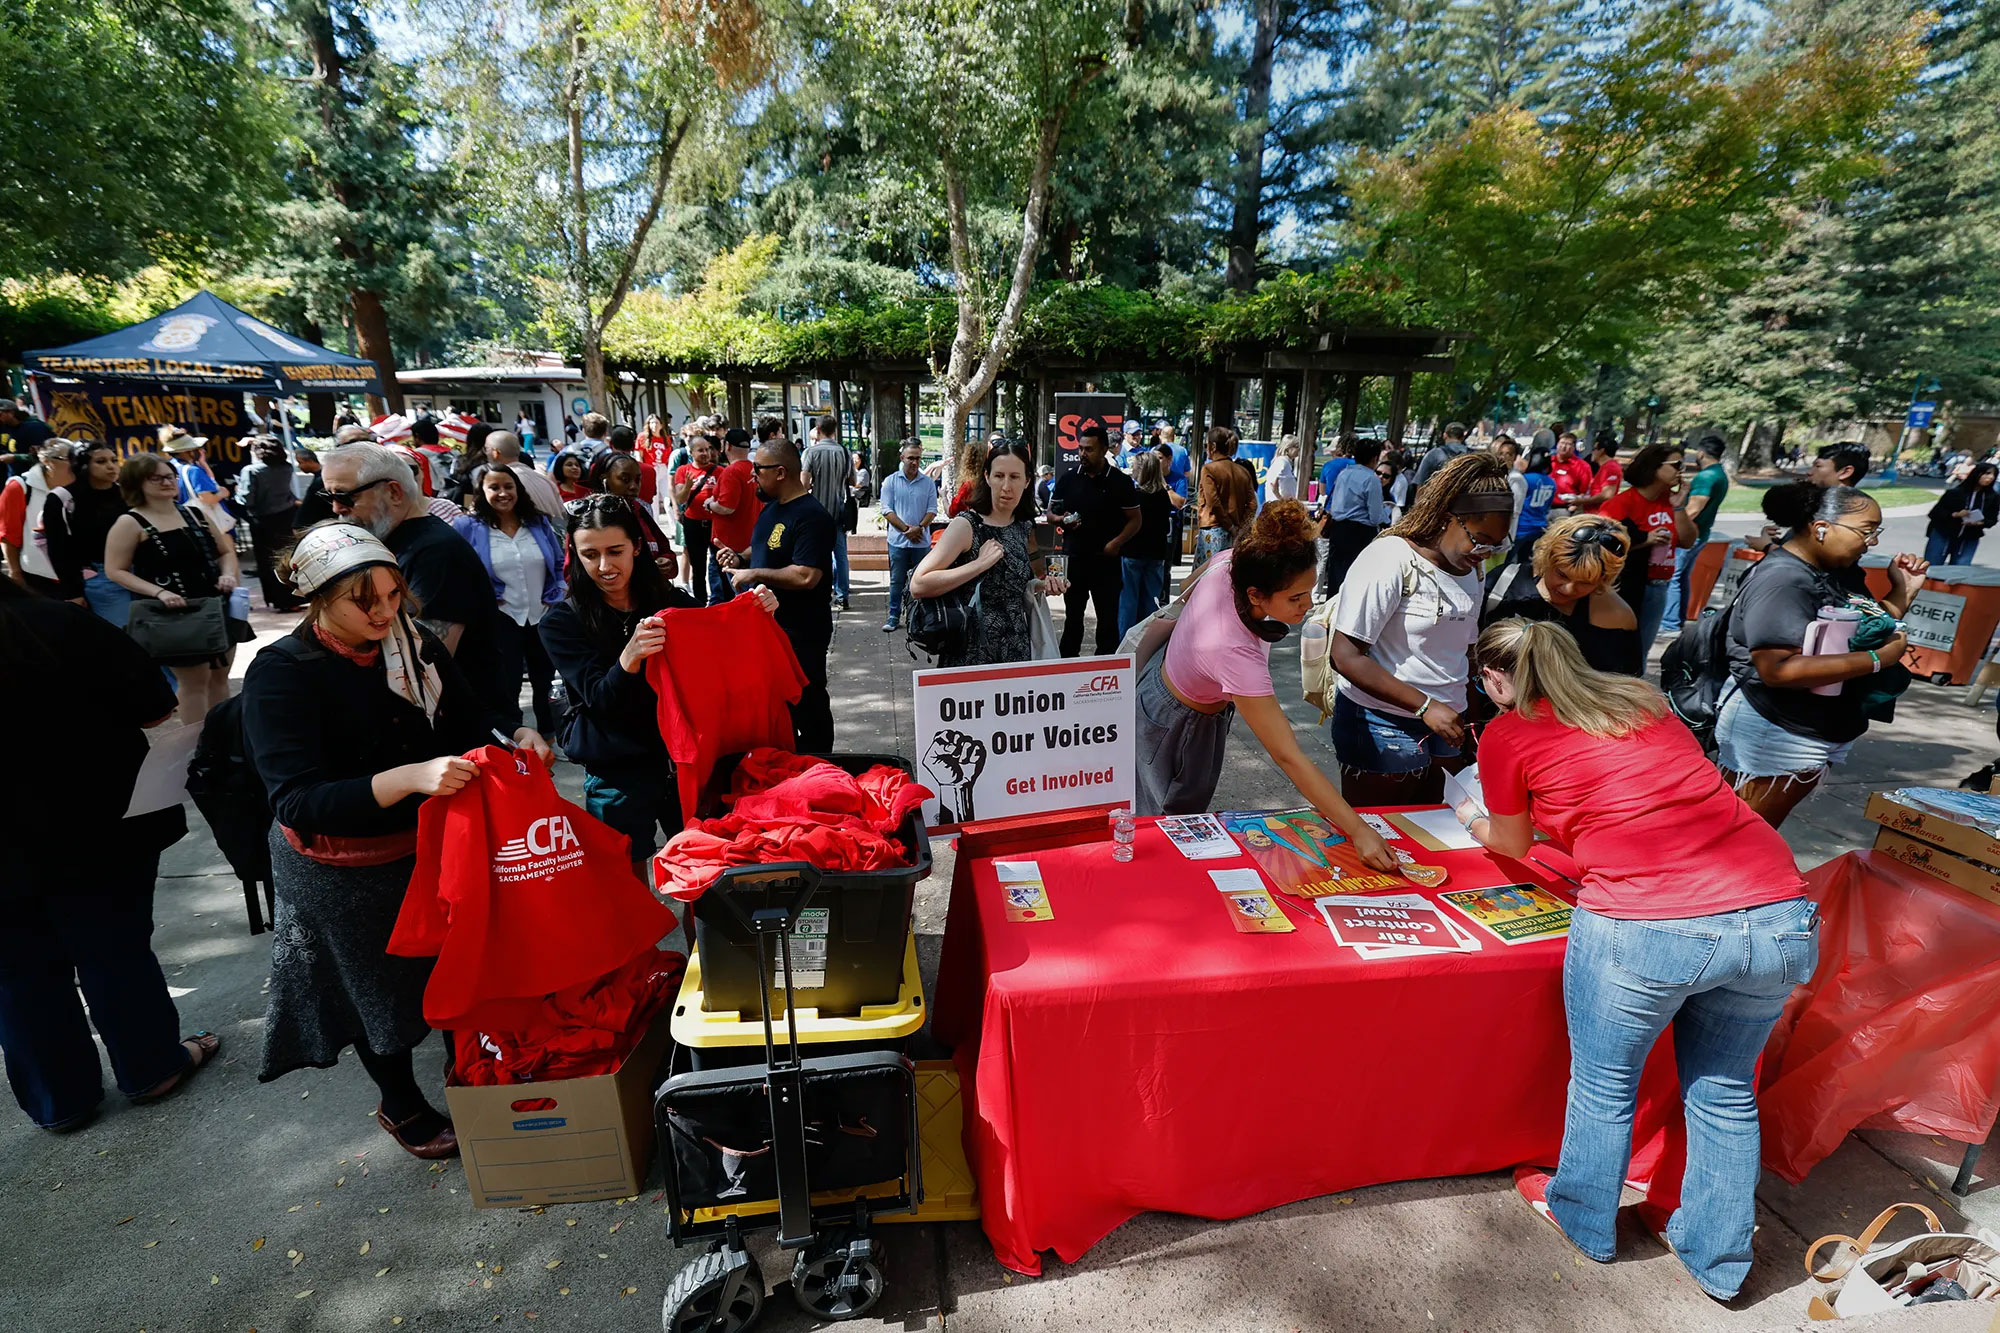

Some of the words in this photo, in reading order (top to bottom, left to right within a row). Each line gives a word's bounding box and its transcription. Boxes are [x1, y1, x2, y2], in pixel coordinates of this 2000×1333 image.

[38, 356, 149, 374] TEAMSTERS
[154, 357, 217, 377] LOCAL
[220, 365, 264, 379] 2010
[281, 364, 333, 380] TEAMSTERS
[101, 394, 238, 427] TEAMSTERS
[1910, 603, 1957, 624] GHER
[1090, 675, 1119, 692] CFA
[940, 697, 985, 722] Our
[994, 690, 1065, 717] Union
[991, 731, 1035, 755] Our
[1043, 723, 1118, 750] Voices
[1006, 776, 1036, 795] Get
[1042, 766, 1114, 791] Involved
[526, 815, 580, 856] CFA
[1891, 817, 1945, 844] Esperanza
[498, 868, 555, 883] SACRAMENTO
[556, 858, 583, 873] CHAPTER
[528, 857, 557, 870] Faculty
[1900, 851, 1950, 879] Esperanza
[1319, 880, 1345, 894] DO
[1339, 877, 1374, 891] CAN
[1367, 874, 1400, 887] WE
[1296, 882, 1325, 897] IT!
[1447, 892, 1478, 902] CFA
[1355, 907, 1411, 920] Now!
[1343, 918, 1437, 933] Contract
[1493, 918, 1536, 932] CONTRACT
[1508, 925, 1546, 937] TOGETHER
[1378, 932, 1421, 945] Fair
